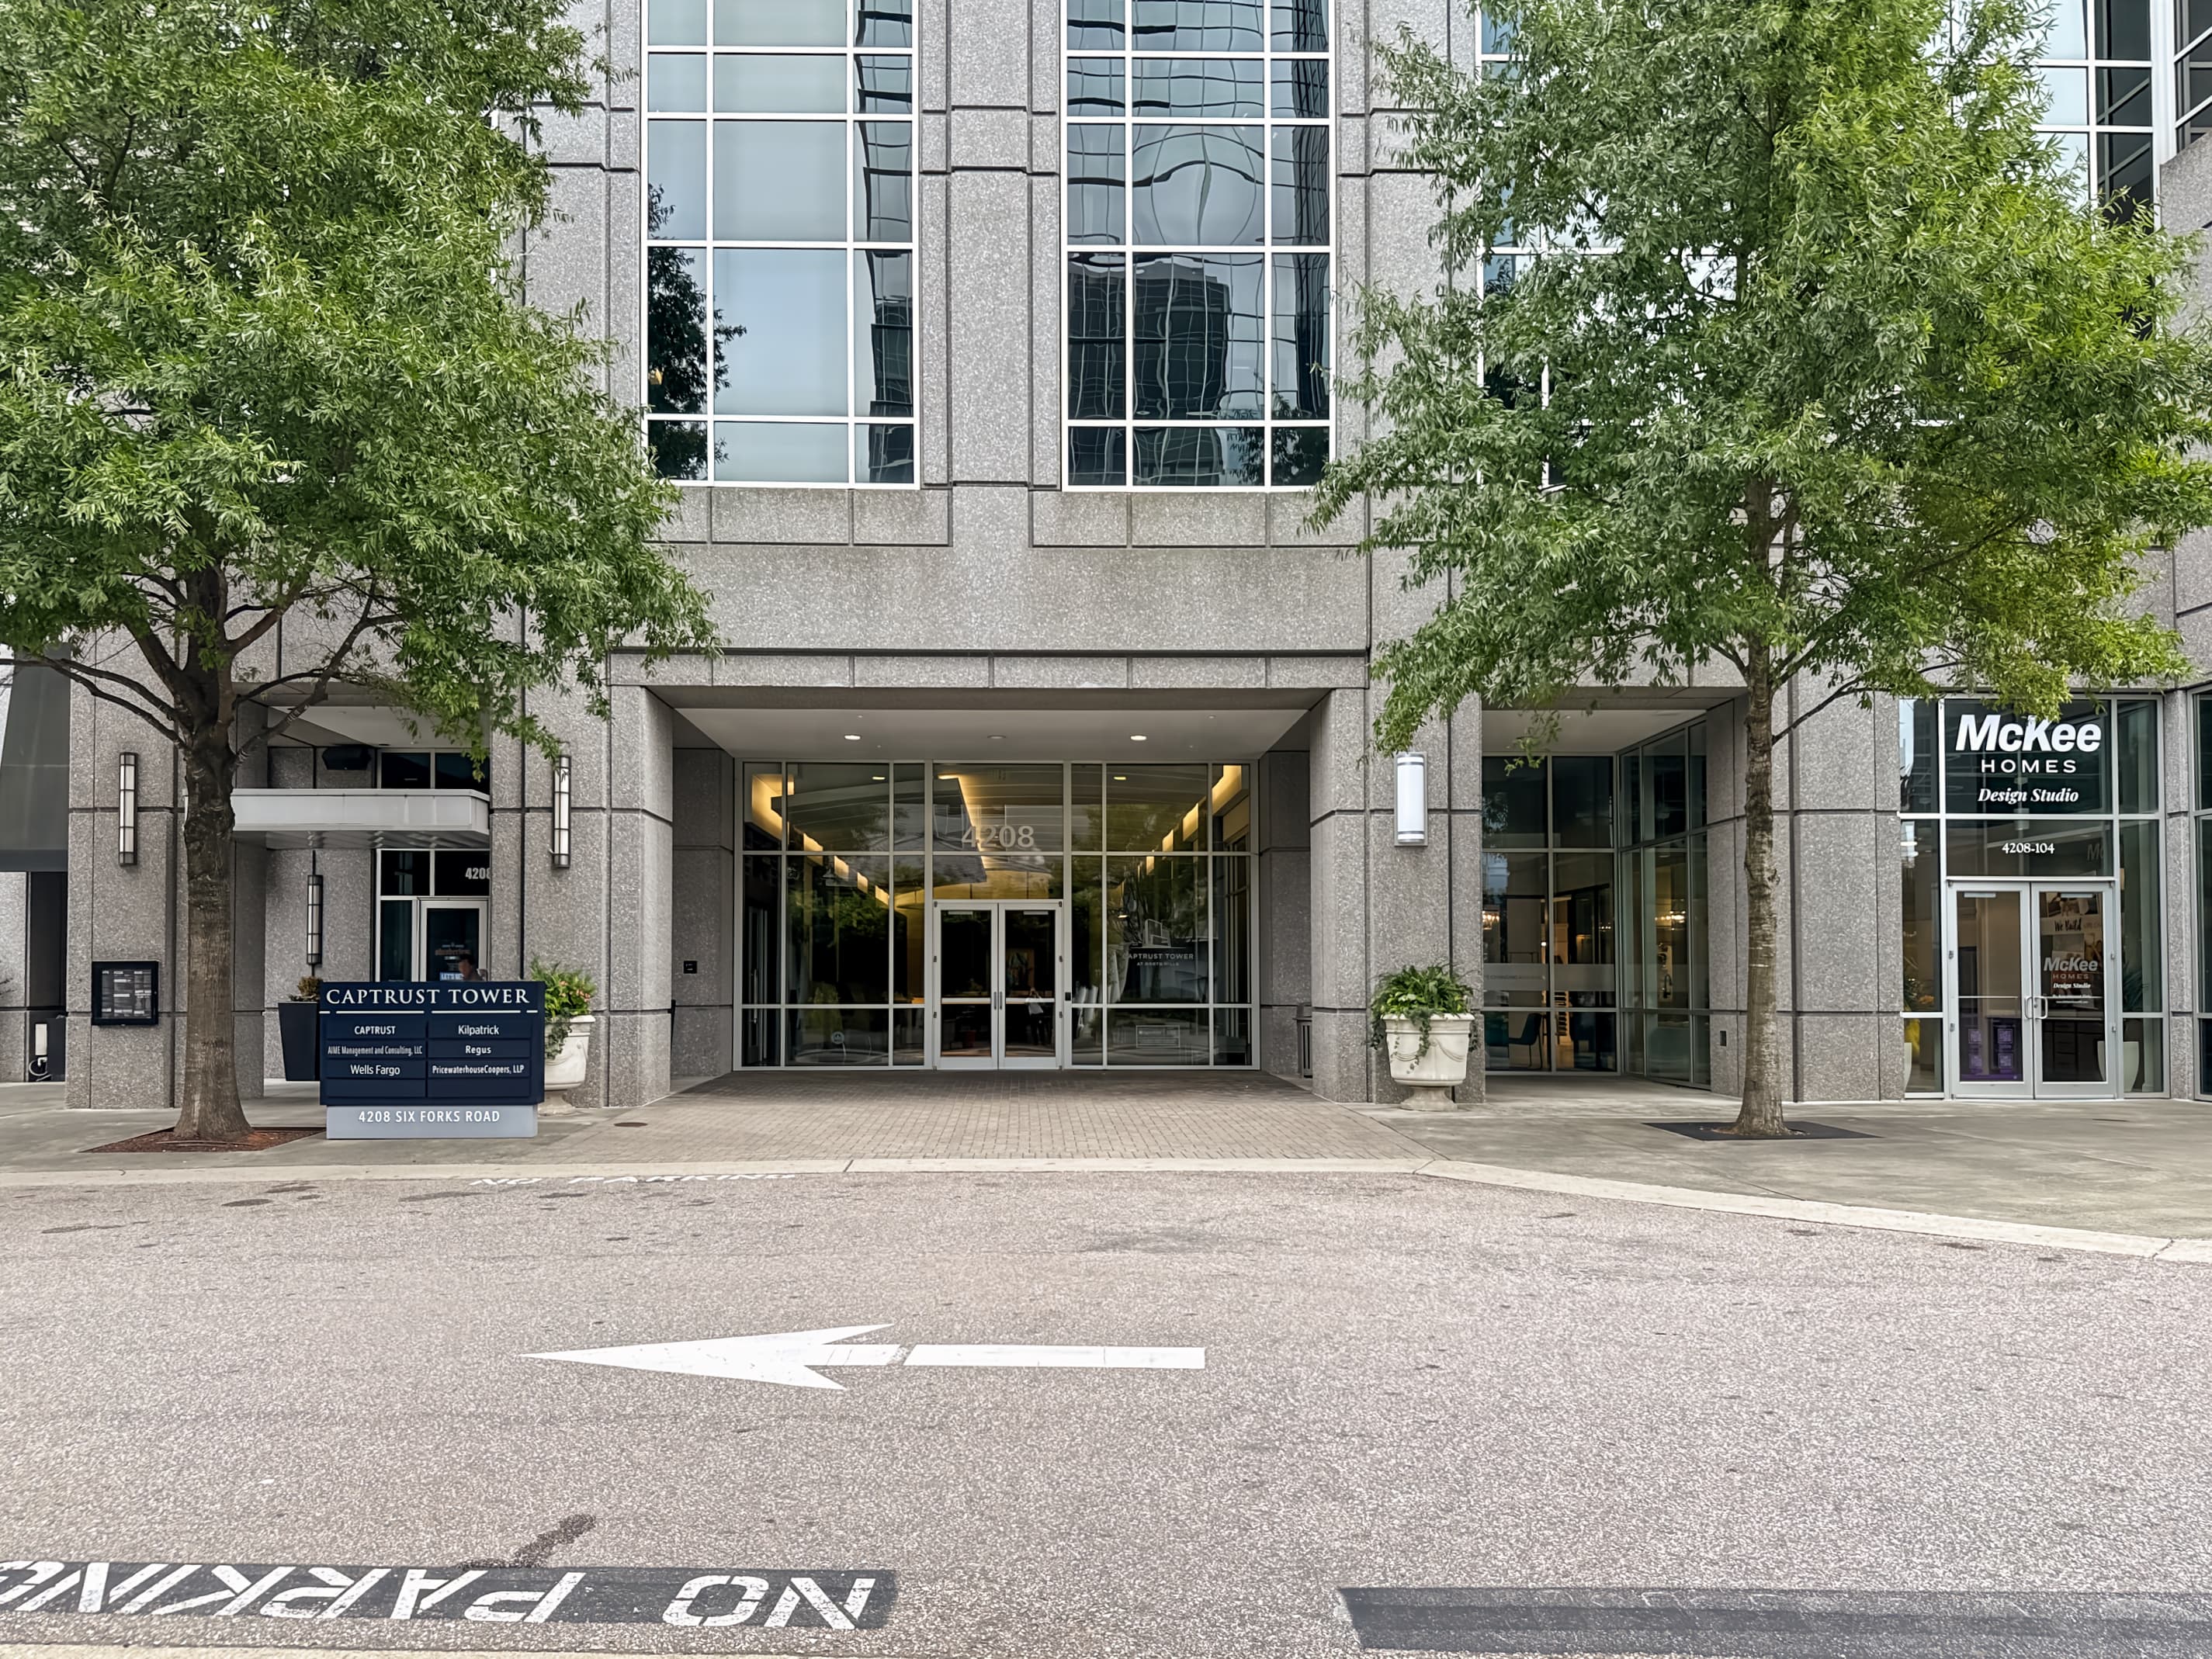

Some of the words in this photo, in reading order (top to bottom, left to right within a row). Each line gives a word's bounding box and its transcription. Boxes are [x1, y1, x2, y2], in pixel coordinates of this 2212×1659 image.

[1955, 714, 2102, 752] McKee
[1981, 759, 2077, 774] HOMES
[1978, 788, 2027, 805] Design
[2030, 788, 2079, 802] Studio
[962, 825, 1035, 848] 4208
[2002, 842, 2055, 854] 4208-104
[2044, 956, 2098, 972] McKee
[326, 989, 439, 1004] CAPTRUST
[448, 989, 530, 1004] TOWER
[354, 1025, 396, 1034] CAPTRUST
[458, 1025, 499, 1036] Kilpatrick
[342, 1045, 373, 1056] Management
[374, 1045, 383, 1055] and
[384, 1045, 413, 1056] Consulting,
[414, 1045, 422, 1055] LLC
[465, 1045, 491, 1055] Regus
[350, 1065, 373, 1075] Wells
[376, 1065, 400, 1076] Fargo
[432, 1064, 511, 1075] PricewaterhouseCoopers,
[512, 1064, 525, 1073] LLP
[359, 1110, 390, 1123] 4208
[395, 1110, 415, 1123] SIX
[420, 1110, 460, 1123] FORKS
[466, 1110, 500, 1123] ROAD
[662, 1575, 876, 1630] NO
